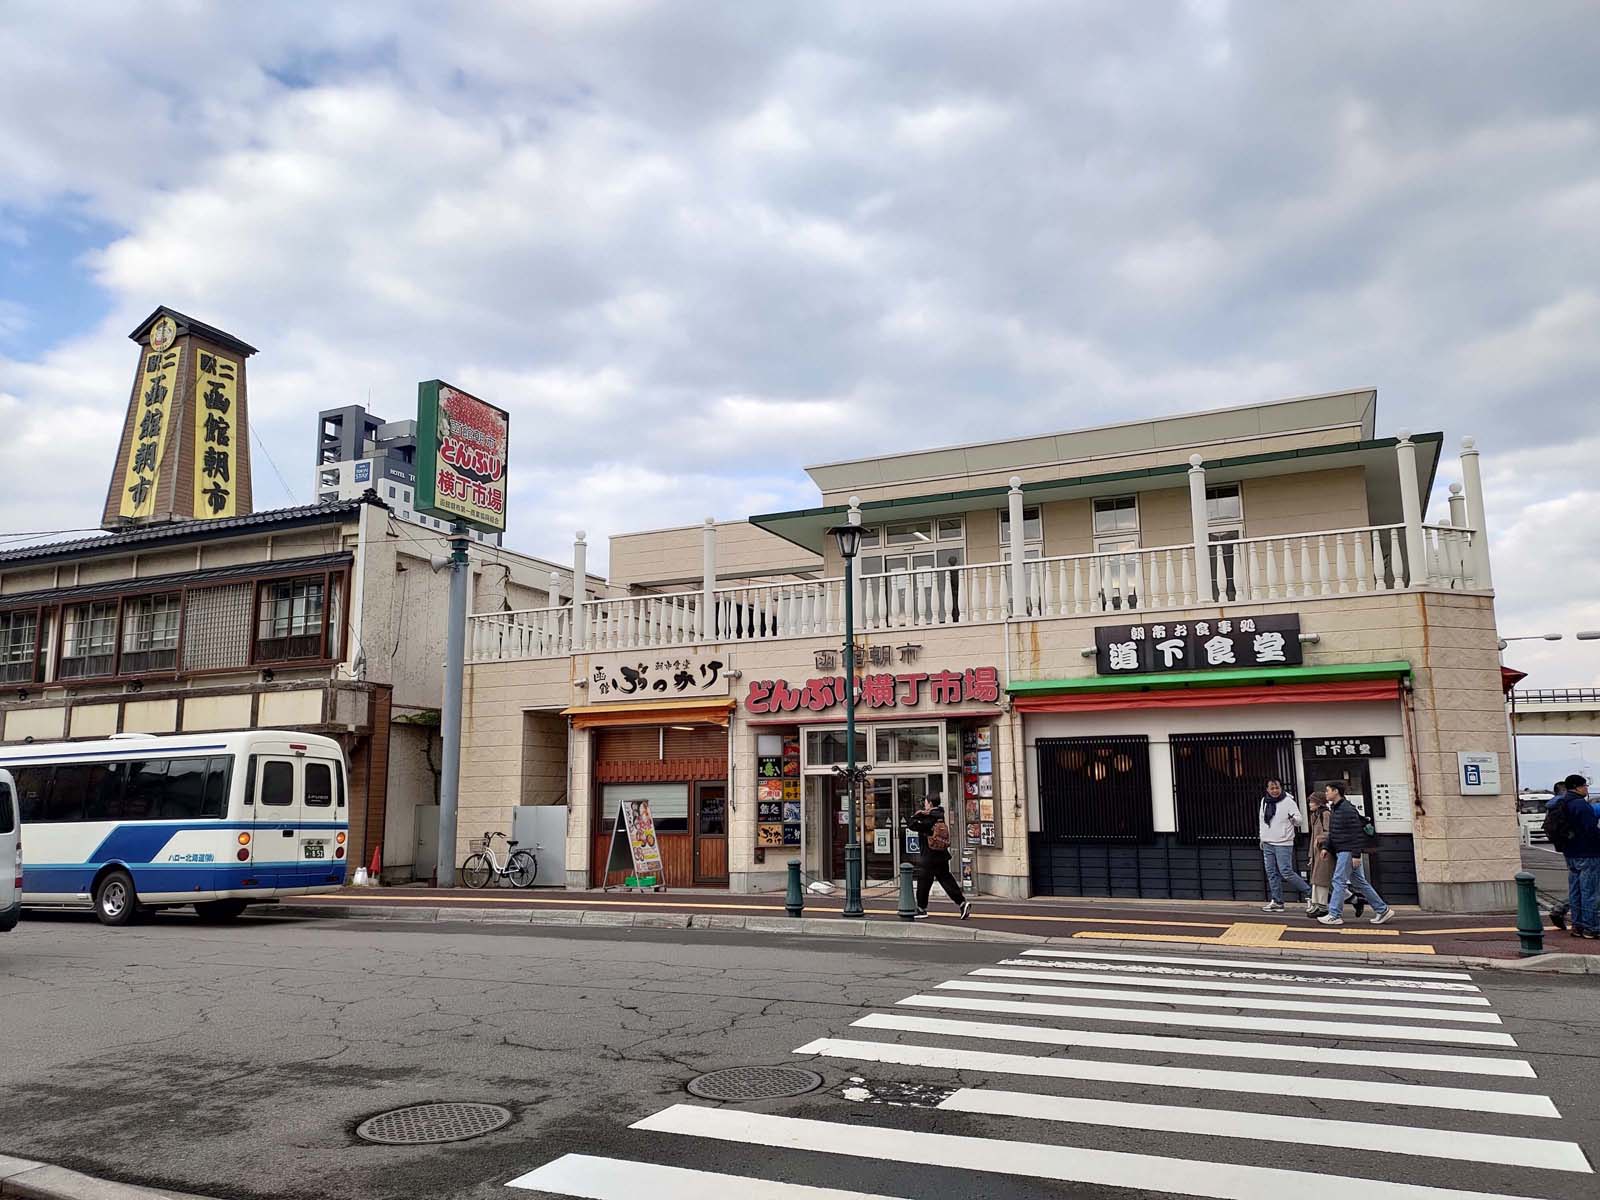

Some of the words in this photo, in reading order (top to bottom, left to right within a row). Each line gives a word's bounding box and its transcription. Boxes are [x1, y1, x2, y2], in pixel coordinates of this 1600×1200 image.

[129, 374, 169, 509] 函館朝市
[203, 380, 231, 514] 函館朝市
[440, 437, 502, 480] どんぶり
[390, 468, 406, 479] HOTEL
[437, 469, 503, 513] 横丁市場
[1131, 619, 1256, 640] 朝市お食事処
[814, 643, 921, 670] 函館朝市
[1109, 632, 1286, 670] 道下食堂
[612, 661, 723, 694] ぶっかけ
[745, 667, 999, 713] どんぶり横丁市場
